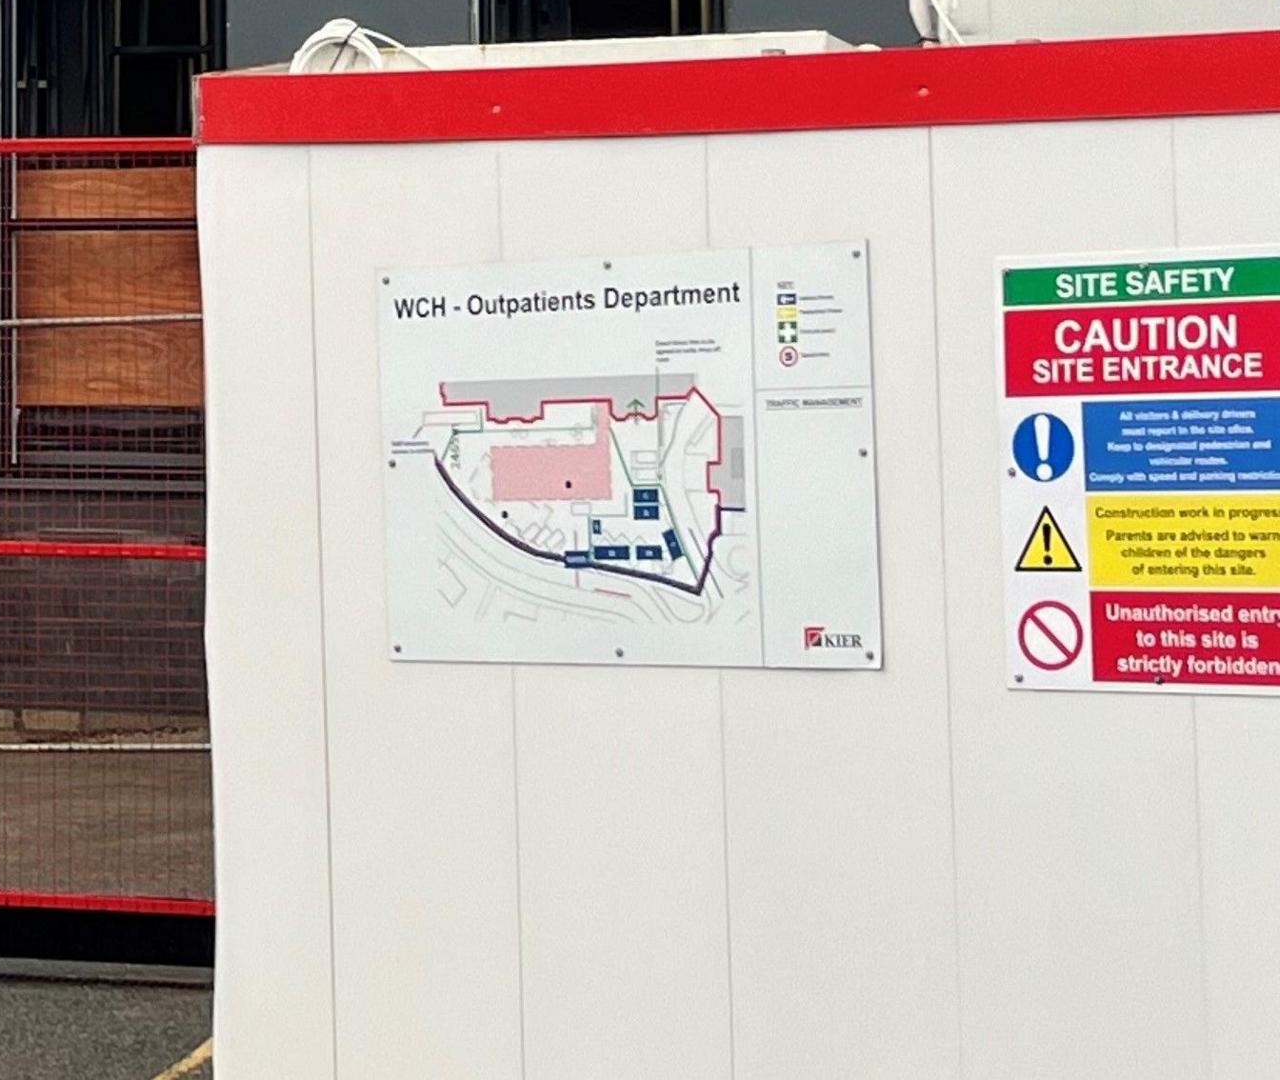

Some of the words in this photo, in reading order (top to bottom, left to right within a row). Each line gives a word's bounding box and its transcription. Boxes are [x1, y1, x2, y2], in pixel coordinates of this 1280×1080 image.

[1055, 273, 1117, 298] SITE
[1126, 267, 1234, 295] SAFETY
[394, 296, 446, 319] WCH
[467, 291, 596, 318] Outpatients
[603, 282, 741, 313] Department
[1054, 314, 1237, 354] CAUTION
[1033, 358, 1094, 384] SITE
[1103, 352, 1263, 381] ENTRANCE
[1095, 506, 1175, 519] Construction
[1179, 506, 1209, 518] work
[1213, 507, 1224, 518] in
[1105, 529, 1153, 541] Parents
[1157, 531, 1176, 541] are
[1180, 529, 1229, 541] advised
[1232, 530, 1246, 541] to
[1249, 531, 1280, 541] warn
[1121, 547, 1171, 558] children
[1174, 547, 1188, 558] of
[1191, 547, 1211, 558] the
[1214, 547, 1267, 561] dangers
[1131, 564, 1144, 575] of
[1147, 564, 1199, 578] entering
[1203, 564, 1227, 575] this
[1230, 564, 1256, 575] site.
[1105, 603, 1233, 623] Unauthorised
[824, 634, 863, 648] KIER
[1136, 629, 1156, 648] to
[1160, 629, 1197, 648] this
[1201, 631, 1237, 649] site
[1241, 630, 1259, 649] is
[1117, 654, 1183, 678] strictly
[1187, 655, 1280, 677] forbidden
